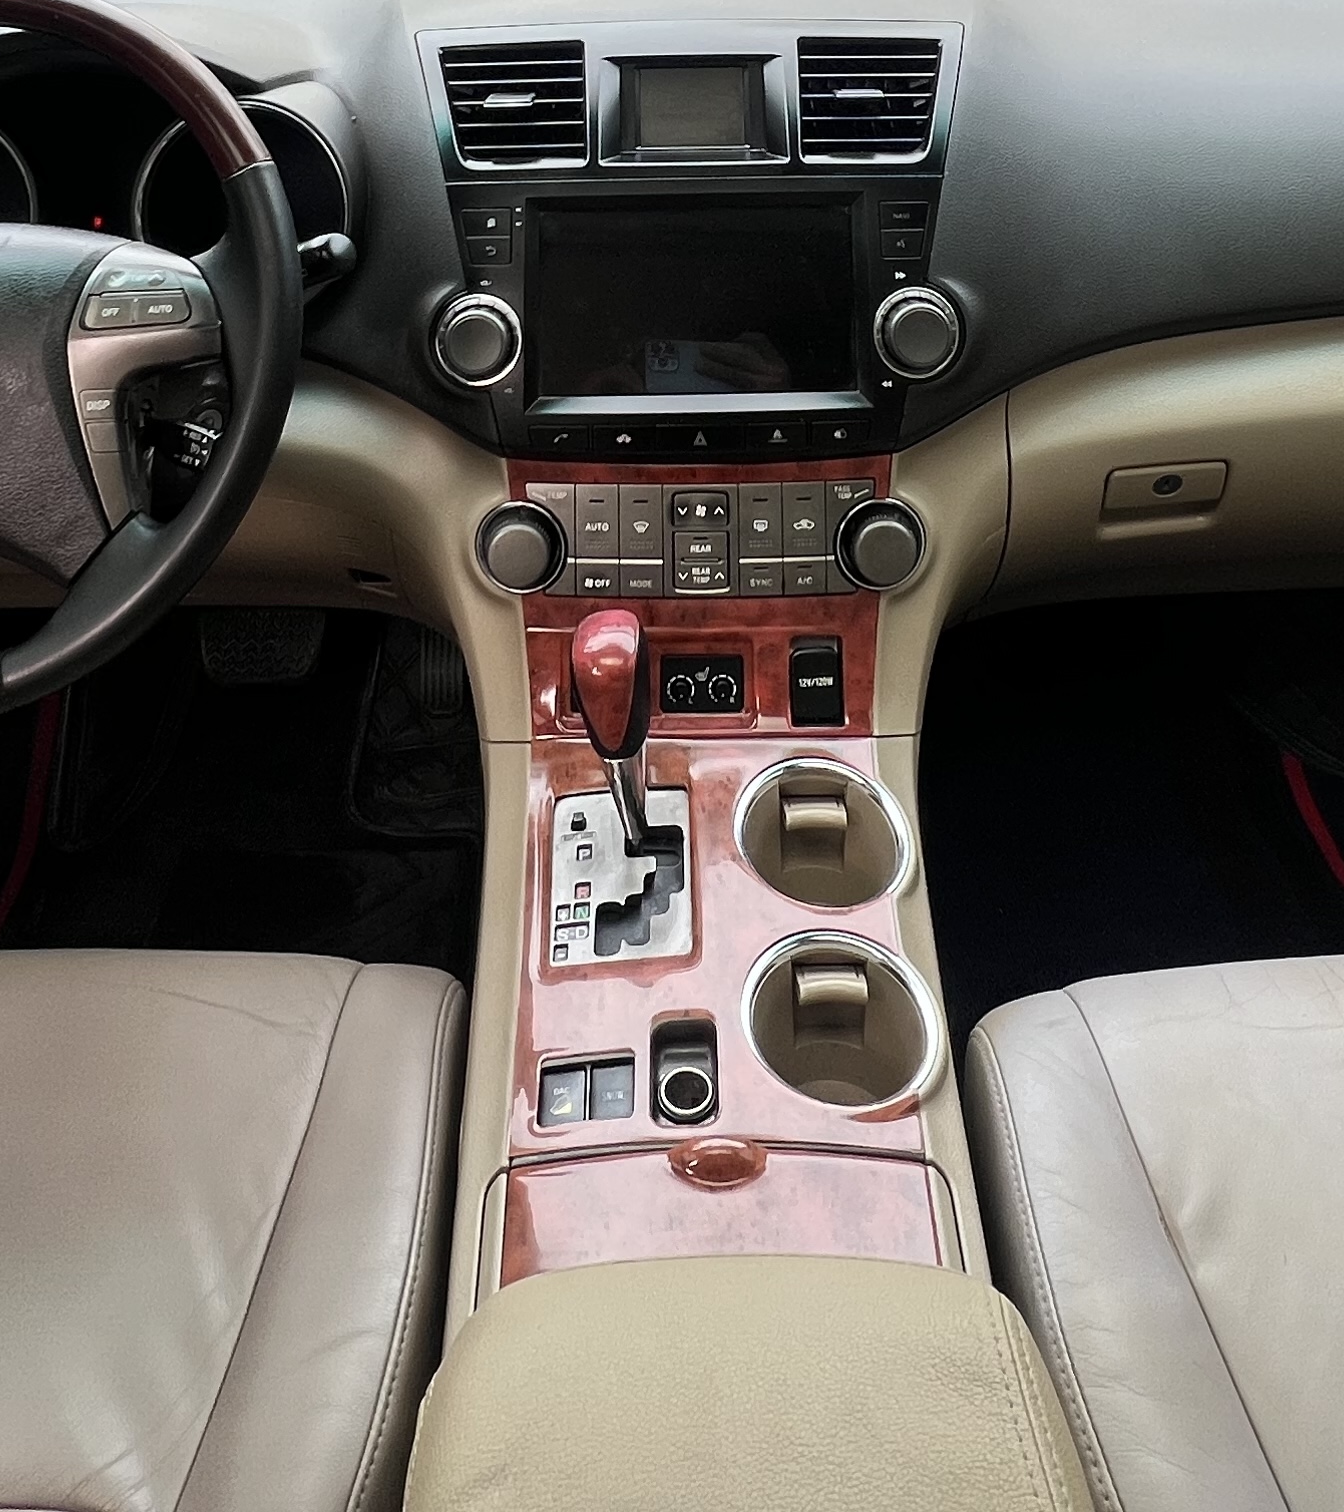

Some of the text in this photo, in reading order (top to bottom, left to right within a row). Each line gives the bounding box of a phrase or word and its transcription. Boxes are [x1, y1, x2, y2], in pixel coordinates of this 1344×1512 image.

[101, 303, 173, 318] OFF AUTO
[85, 399, 111, 412] DISP
[585, 522, 610, 532] AUTO
[690, 544, 712, 554] REAR
[594, 579, 611, 588] OFF
[629, 580, 653, 589] MODE
[749, 578, 774, 588] SYNC
[797, 576, 813, 586] A/C
[578, 848, 591, 861] P
[576, 886, 591, 899] R
[574, 905, 590, 919] N
